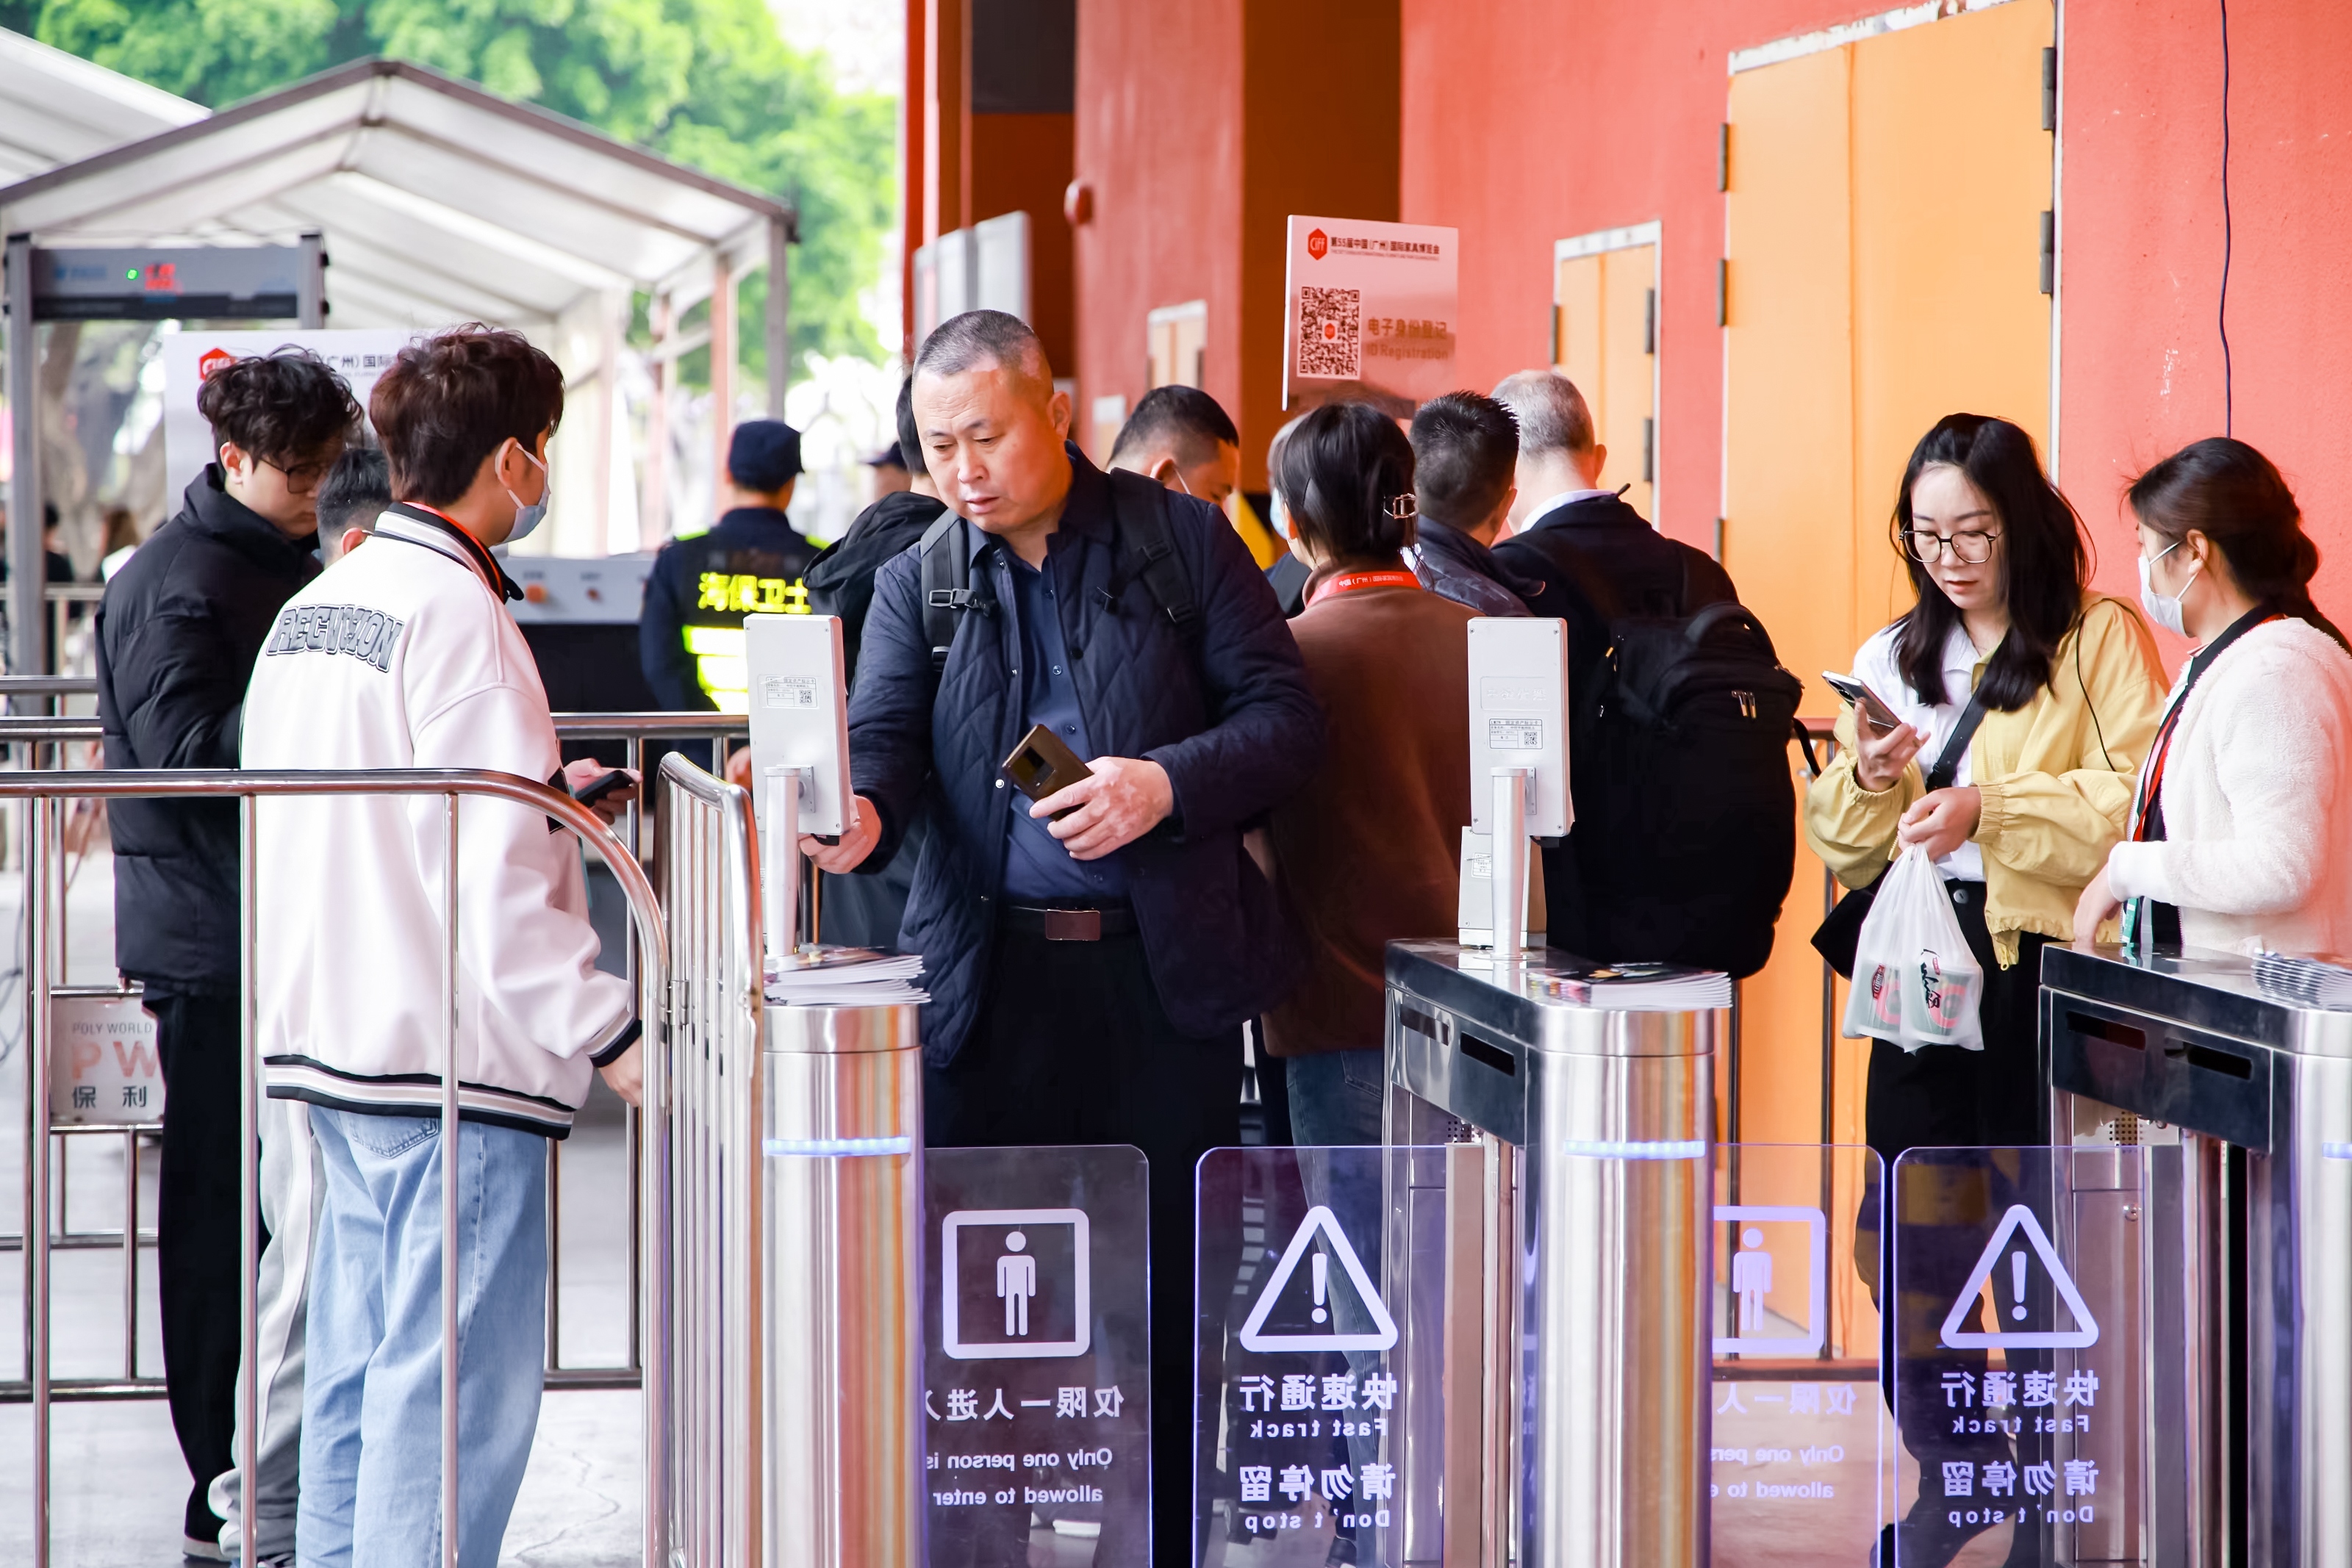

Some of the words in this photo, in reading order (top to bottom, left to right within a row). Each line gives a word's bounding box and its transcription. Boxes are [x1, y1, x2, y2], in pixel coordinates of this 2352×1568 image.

[1368, 317, 1447, 339] 电子身份登记
[1380, 344, 1448, 360] Registration
[74, 1022, 103, 1035] POLY
[107, 1022, 152, 1035] WORLD
[72, 1085, 147, 1108] 保利
